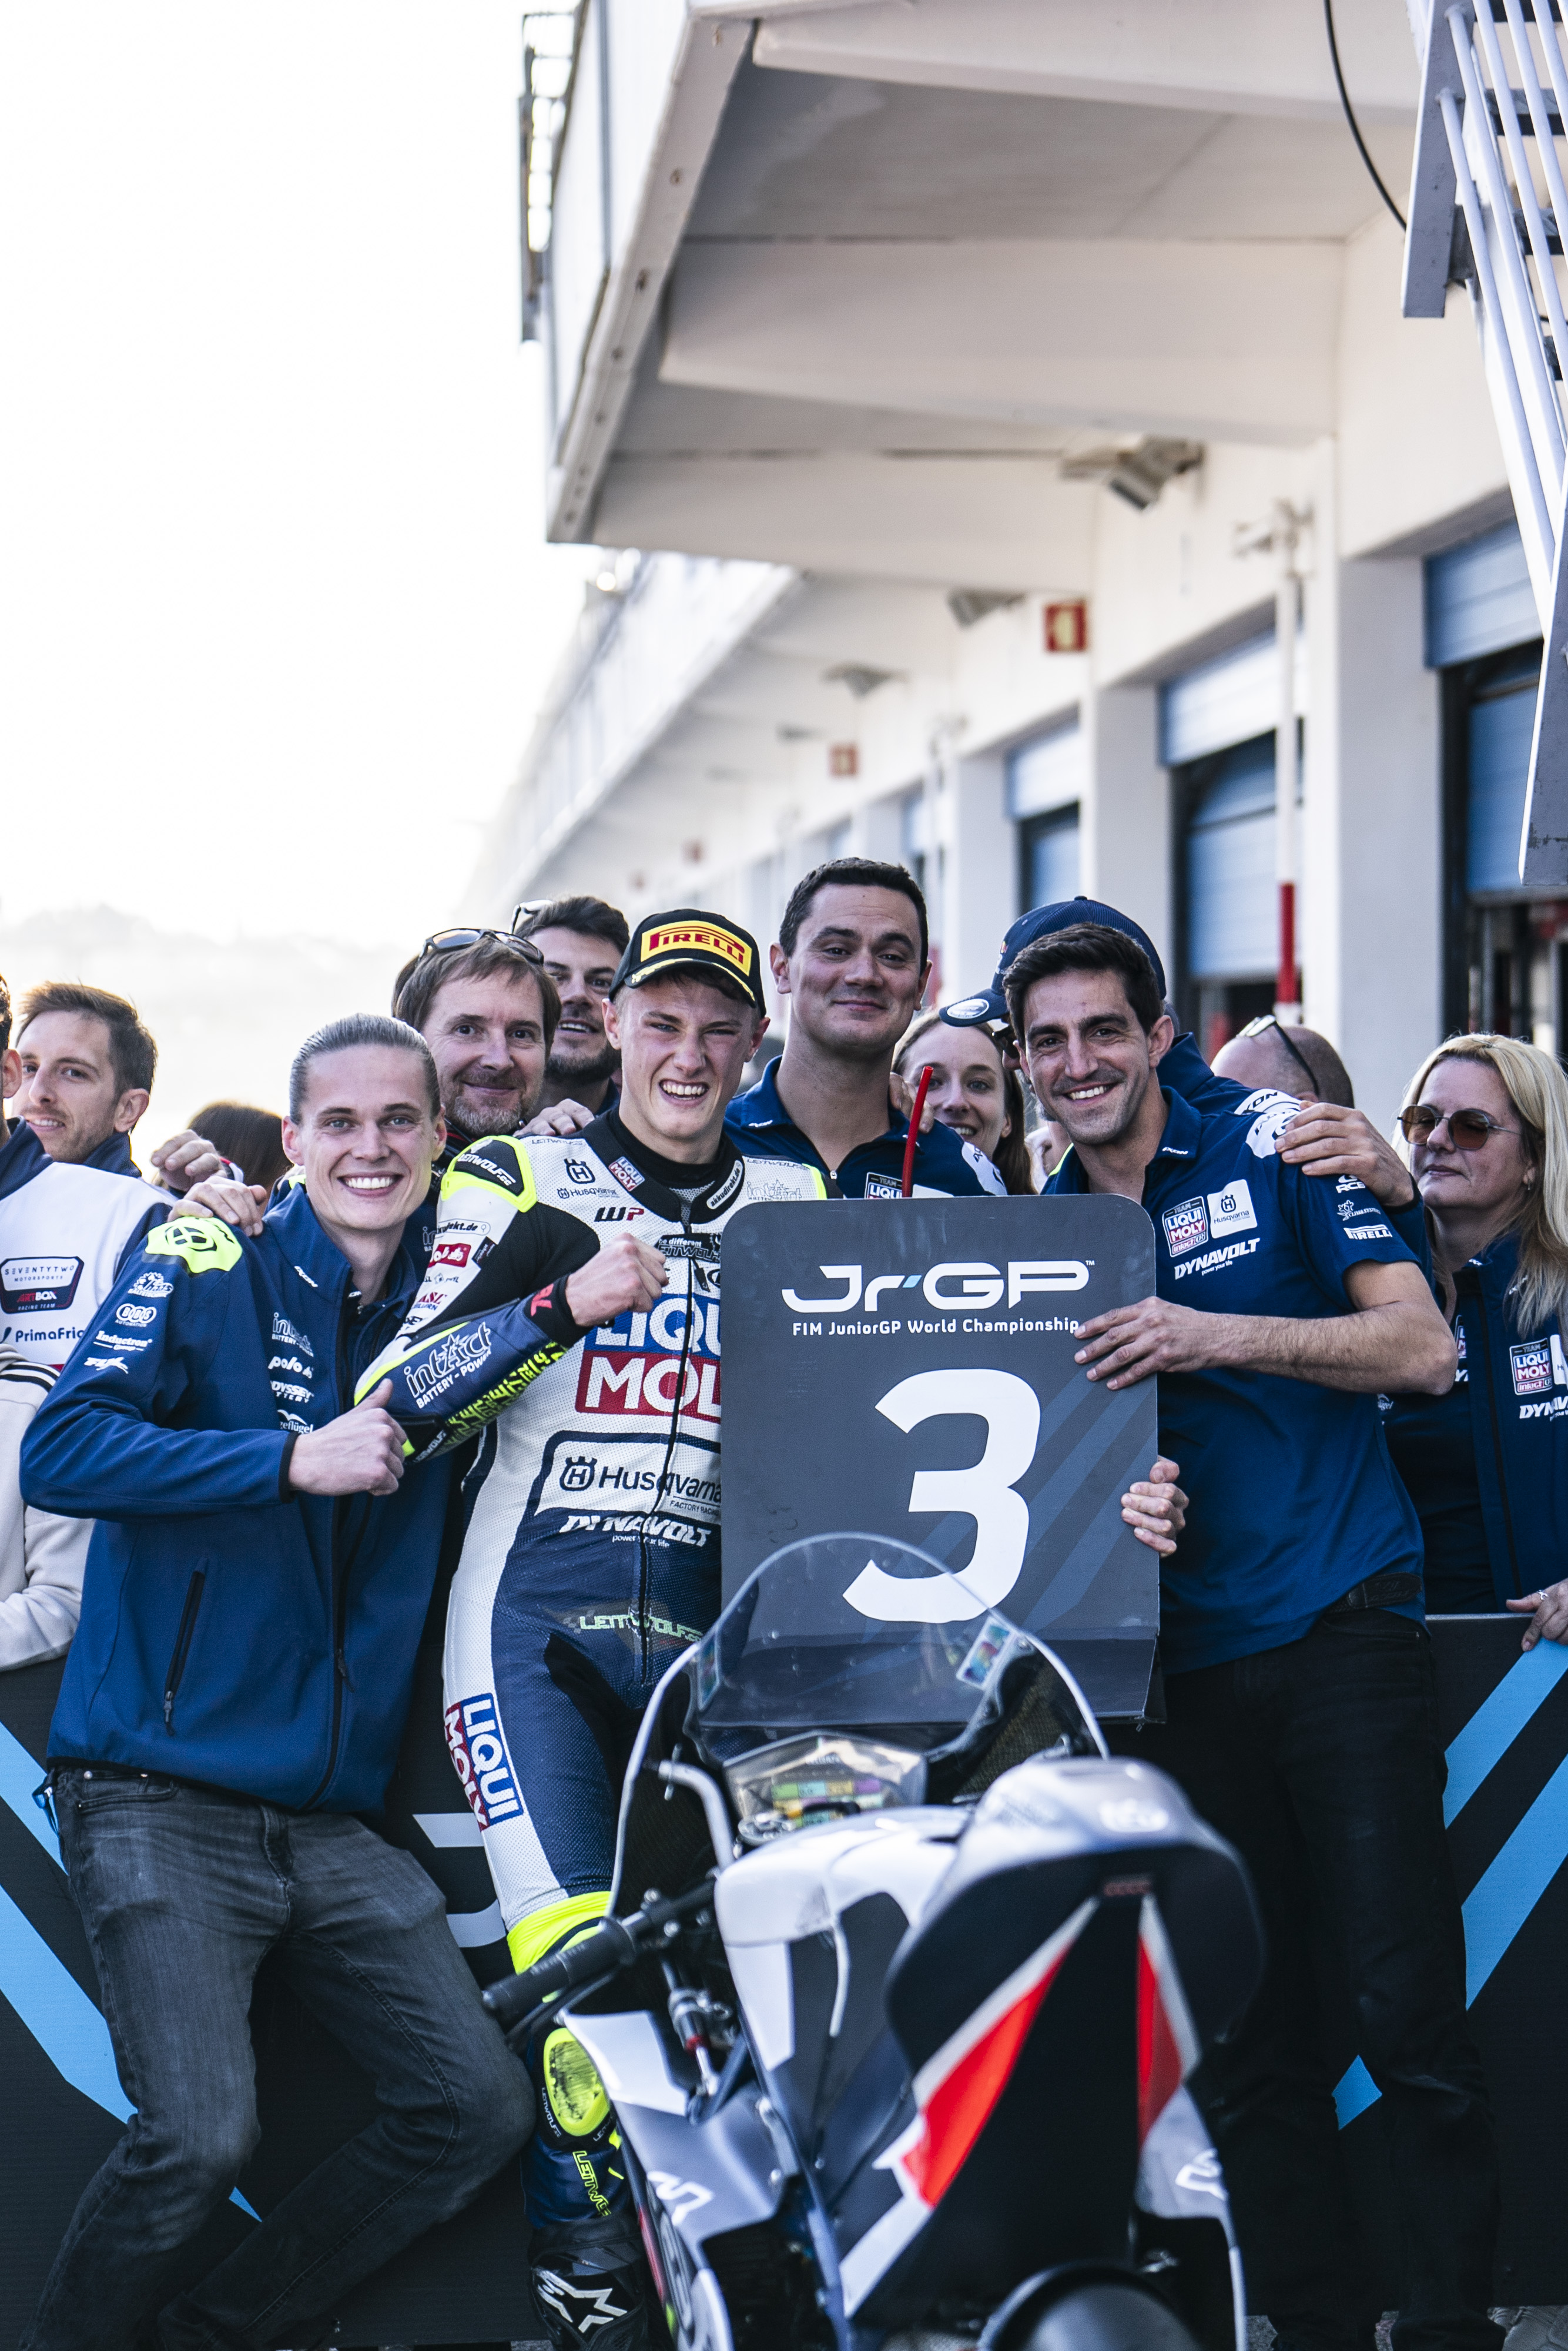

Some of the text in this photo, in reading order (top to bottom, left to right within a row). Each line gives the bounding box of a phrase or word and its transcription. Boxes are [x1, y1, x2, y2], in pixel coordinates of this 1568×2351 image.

[649, 926, 745, 964] PIRELLI
[610, 1161, 636, 1188] MOLY
[618, 1158, 644, 1183] LIQUI
[594, 1207, 645, 1223] WP
[1167, 1208, 1202, 1230] LIQUI
[1213, 1210, 1249, 1225] Husqvarna
[1170, 1220, 1204, 1241] MOLY
[668, 1237, 702, 1247] different
[1174, 1237, 1261, 1280] DYNAVOLT
[4, 1265, 75, 1275] SEVENTYTWO
[1201, 1267, 1215, 1276] power
[1214, 1263, 1226, 1271] your
[792, 1316, 1080, 1336] FIM JuniorGP World Championship
[95, 1330, 148, 1348] Inductron
[267, 1355, 303, 1373] polo
[1516, 1350, 1549, 1368] LIQUI
[1517, 1362, 1550, 1380] MOLY
[270, 1380, 311, 1399] DYSSEY
[415, 1375, 454, 1409] BATTERY
[584, 1356, 722, 1418] MOL
[842, 1368, 1041, 1624] 3
[669, 1499, 700, 1514] FACTORY
[612, 1535, 636, 1543] power
[658, 1539, 670, 1548] life
[444, 1708, 488, 1827] MOLY
[463, 1699, 520, 1820] LIQUI
